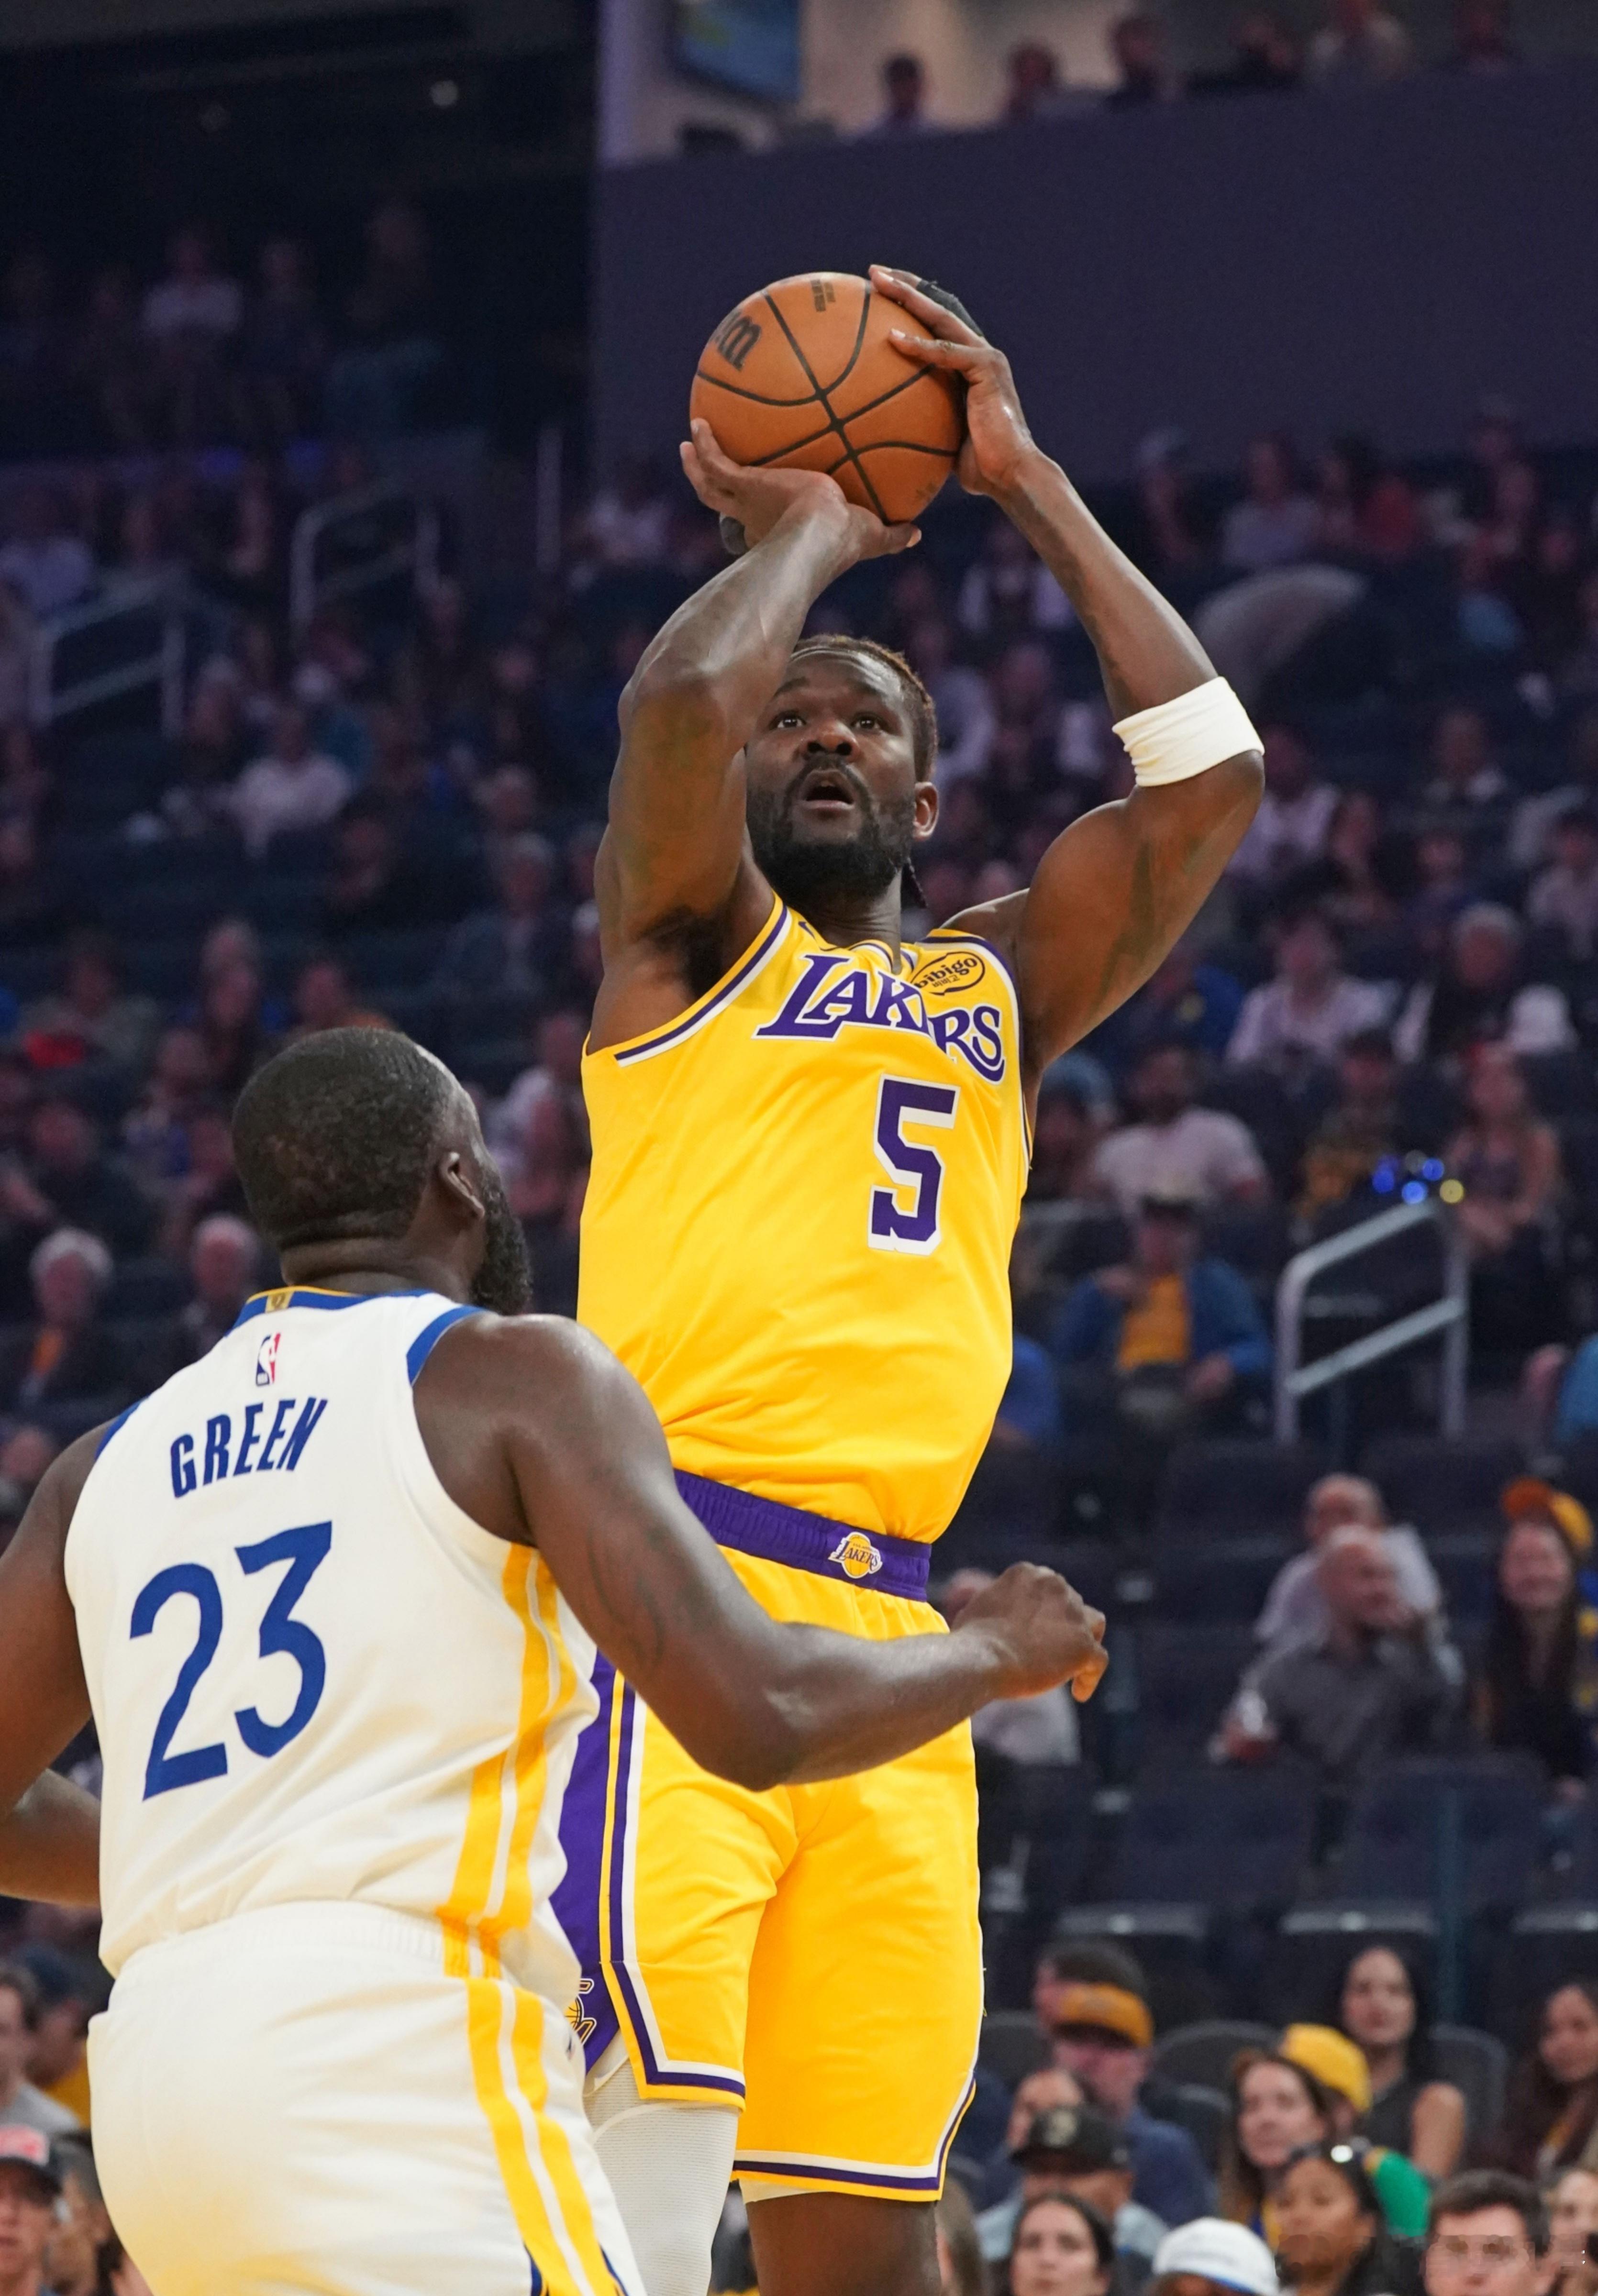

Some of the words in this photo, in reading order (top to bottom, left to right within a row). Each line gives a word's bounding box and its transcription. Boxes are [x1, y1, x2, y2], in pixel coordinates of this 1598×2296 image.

[752, 952, 1006, 1085] LAKRS
[867, 1074, 961, 1256] 5
[170, 1396, 329, 1499] GREEN
[830, 1538, 882, 1573] LAKERS
[130, 1520, 333, 1802] 23
